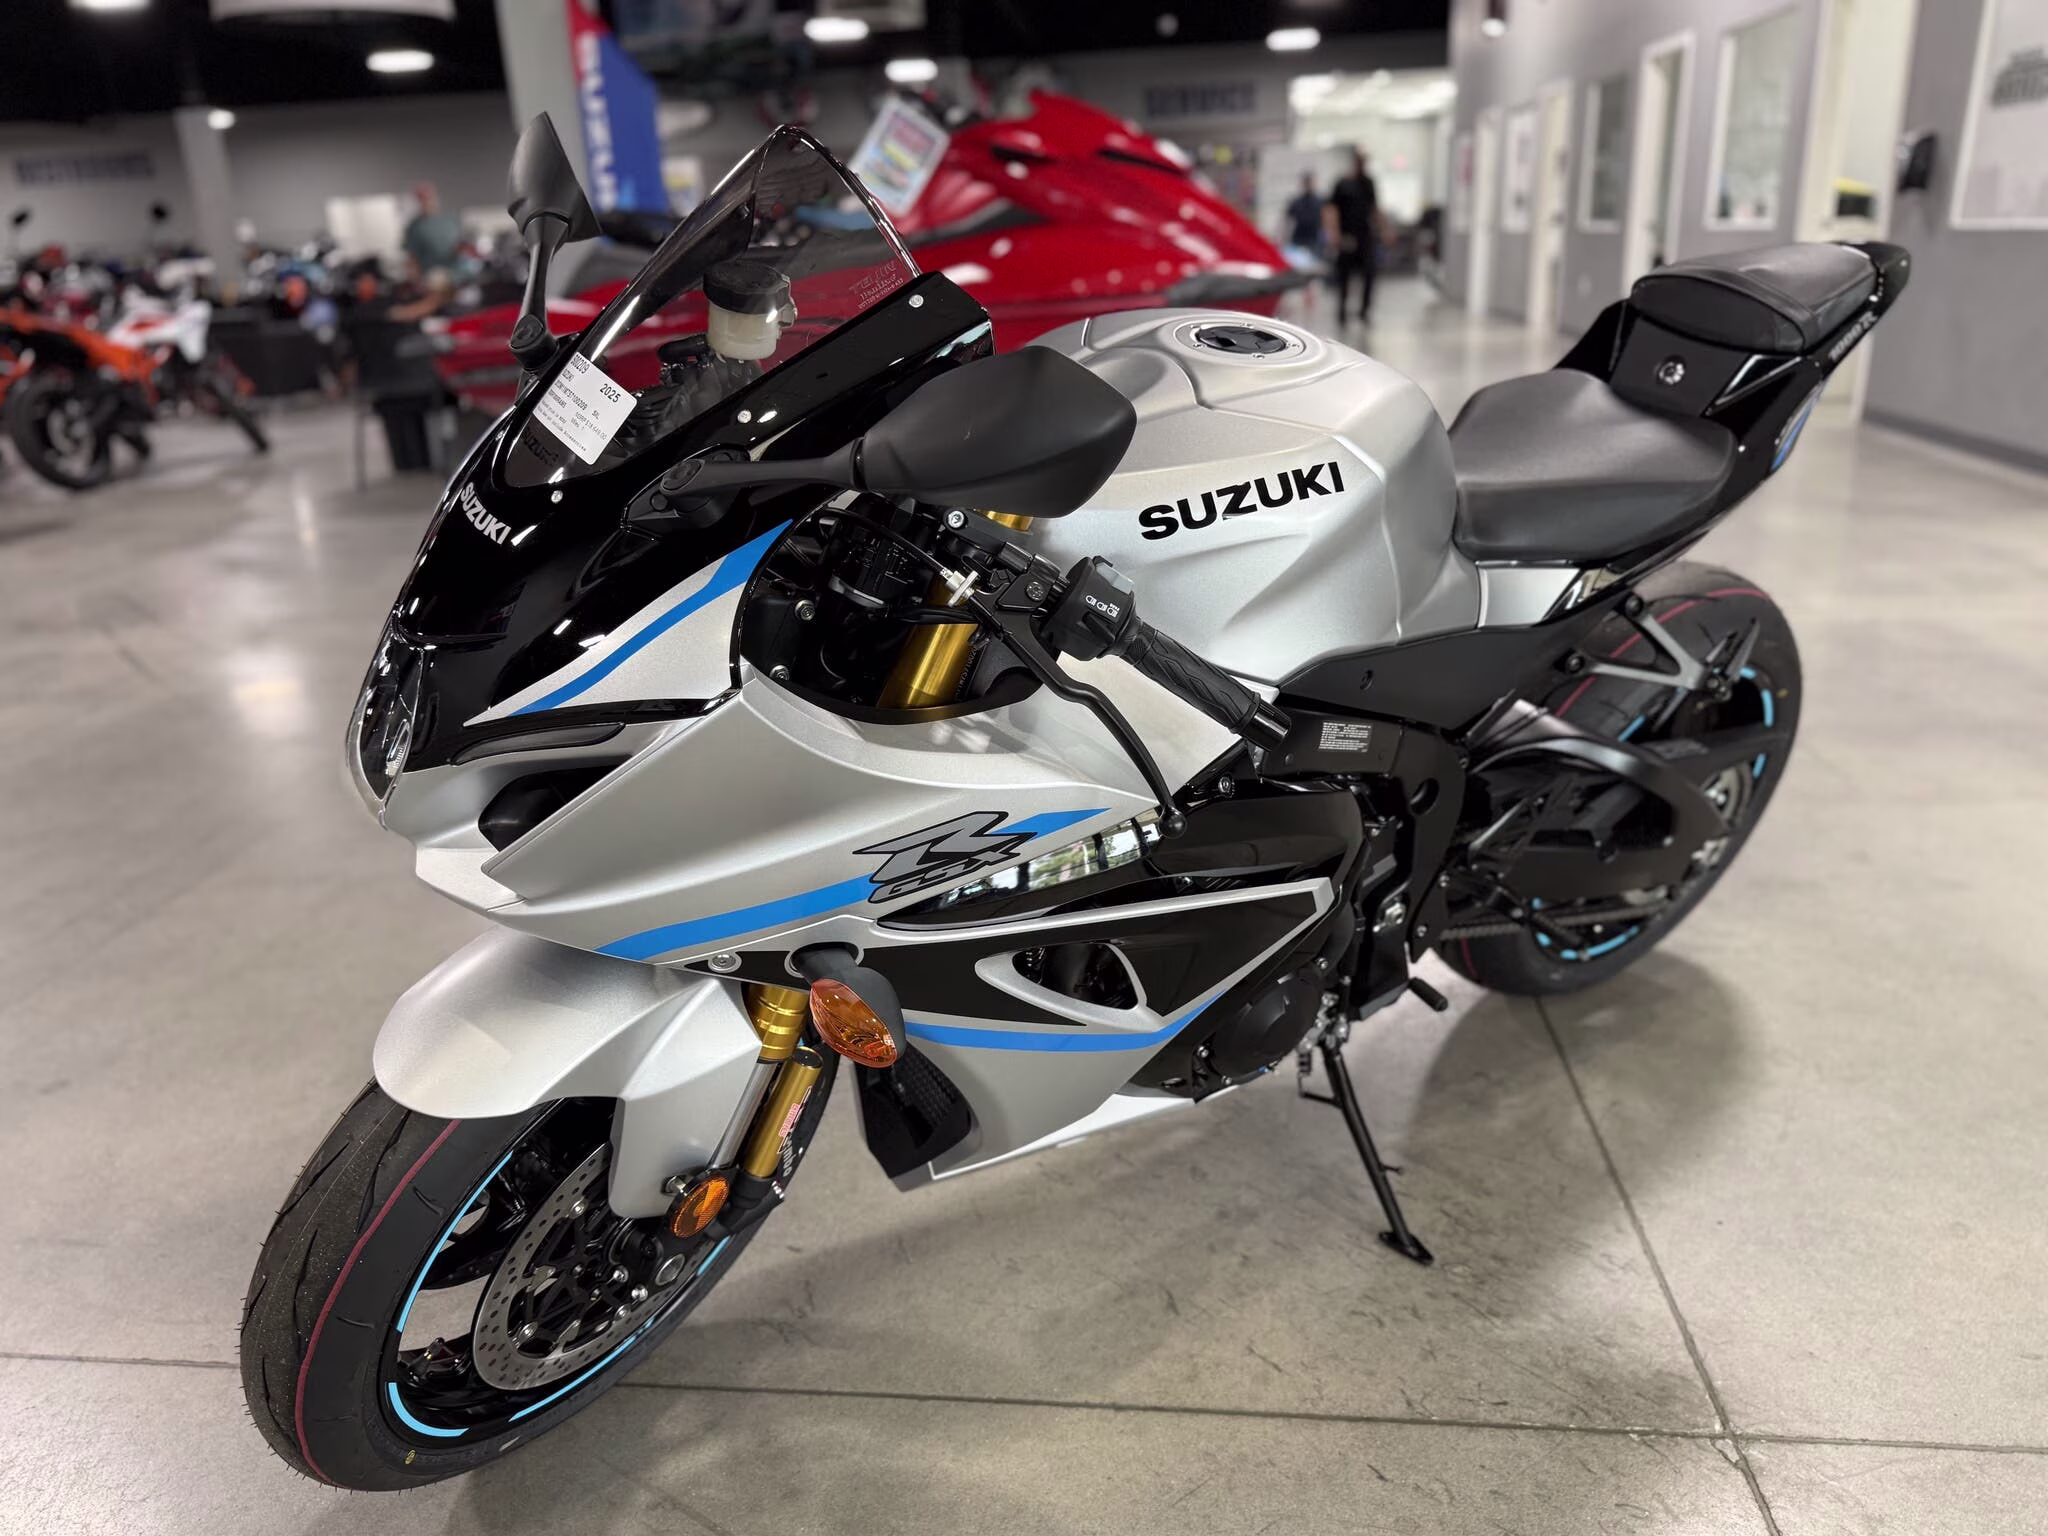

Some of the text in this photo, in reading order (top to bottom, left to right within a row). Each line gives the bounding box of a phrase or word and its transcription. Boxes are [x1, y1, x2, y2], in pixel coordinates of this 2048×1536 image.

[600, 383, 621, 403] 2025
[461, 482, 512, 545] SUZUKI
[1138, 461, 1345, 541] SUZUKI
